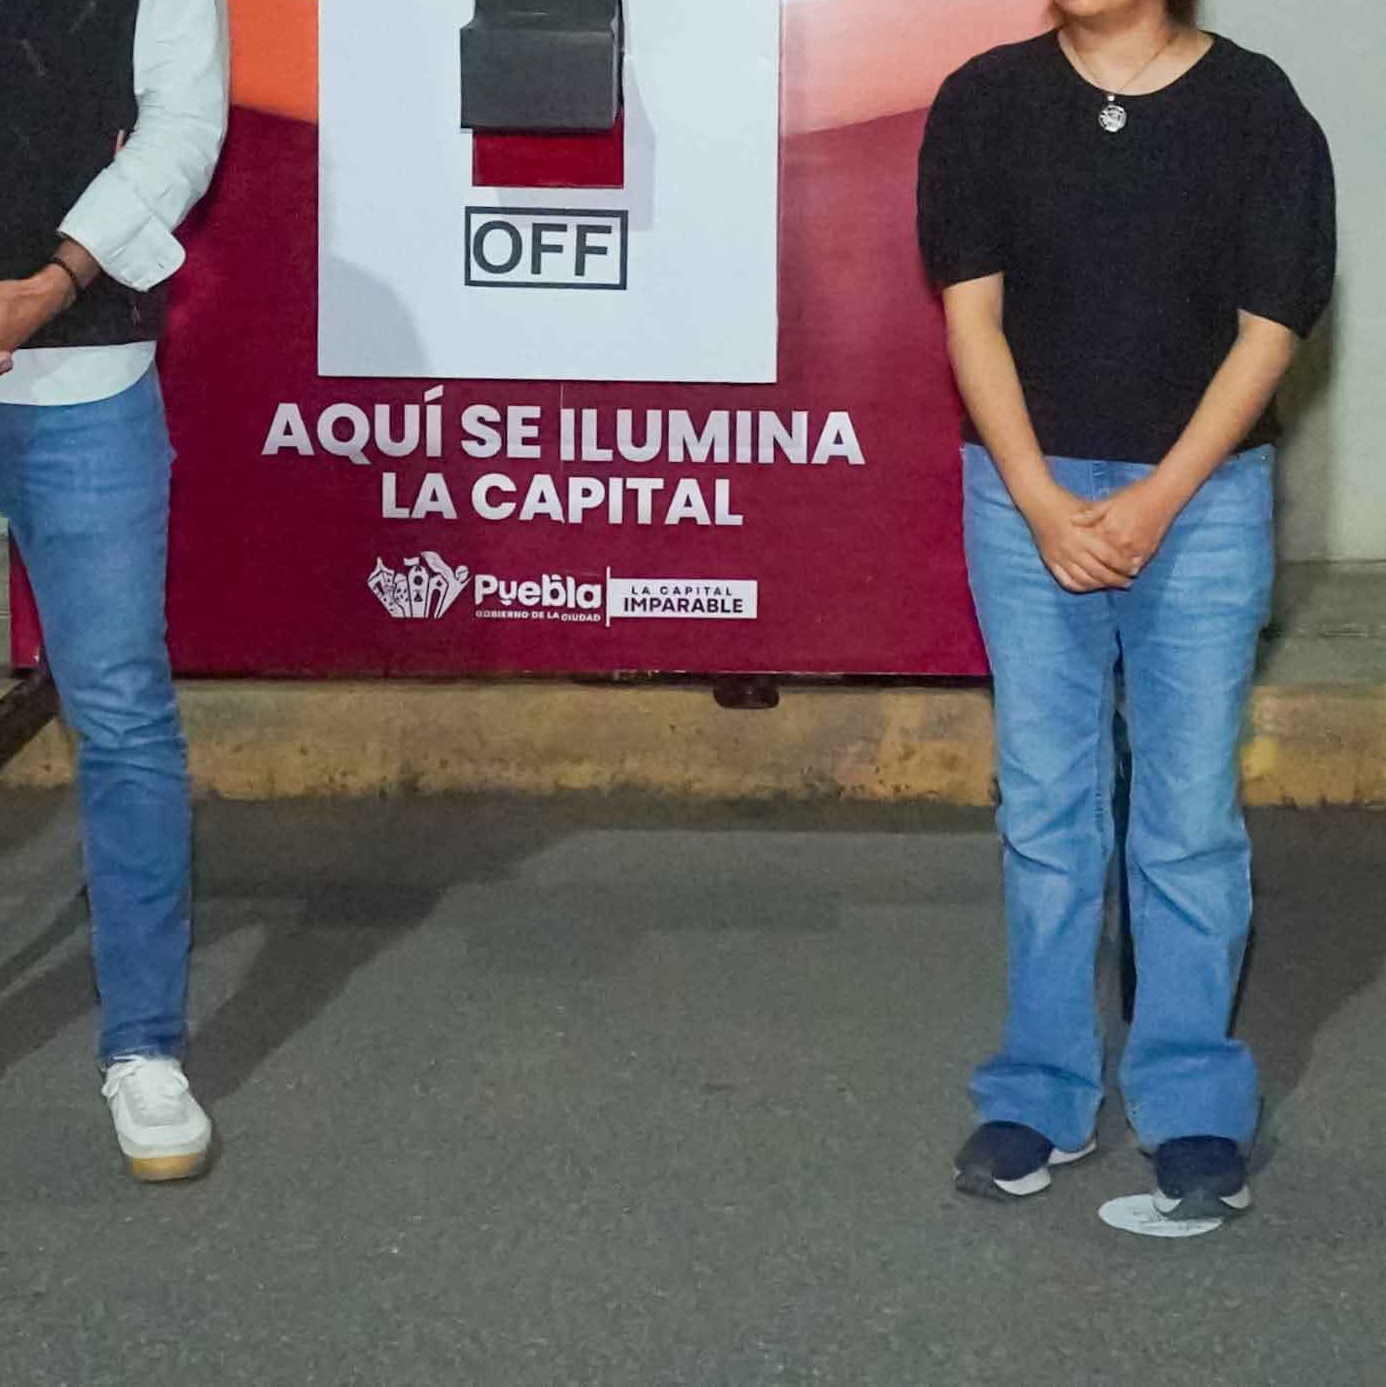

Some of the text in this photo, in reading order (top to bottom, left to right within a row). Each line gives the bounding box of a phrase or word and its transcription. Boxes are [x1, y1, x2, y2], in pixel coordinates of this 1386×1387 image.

[472, 219, 613, 277] OFF
[261, 384, 866, 466] AQUÍ SE ILUMINA
[381, 472, 744, 526] LA CAPITAL
[475, 574, 601, 609] Puebla
[623, 597, 744, 614] IMPARABLE
[631, 585, 733, 597] LA CAPITAL
[475, 610, 601, 622] GOBIERNO DE LA CIUDAD
